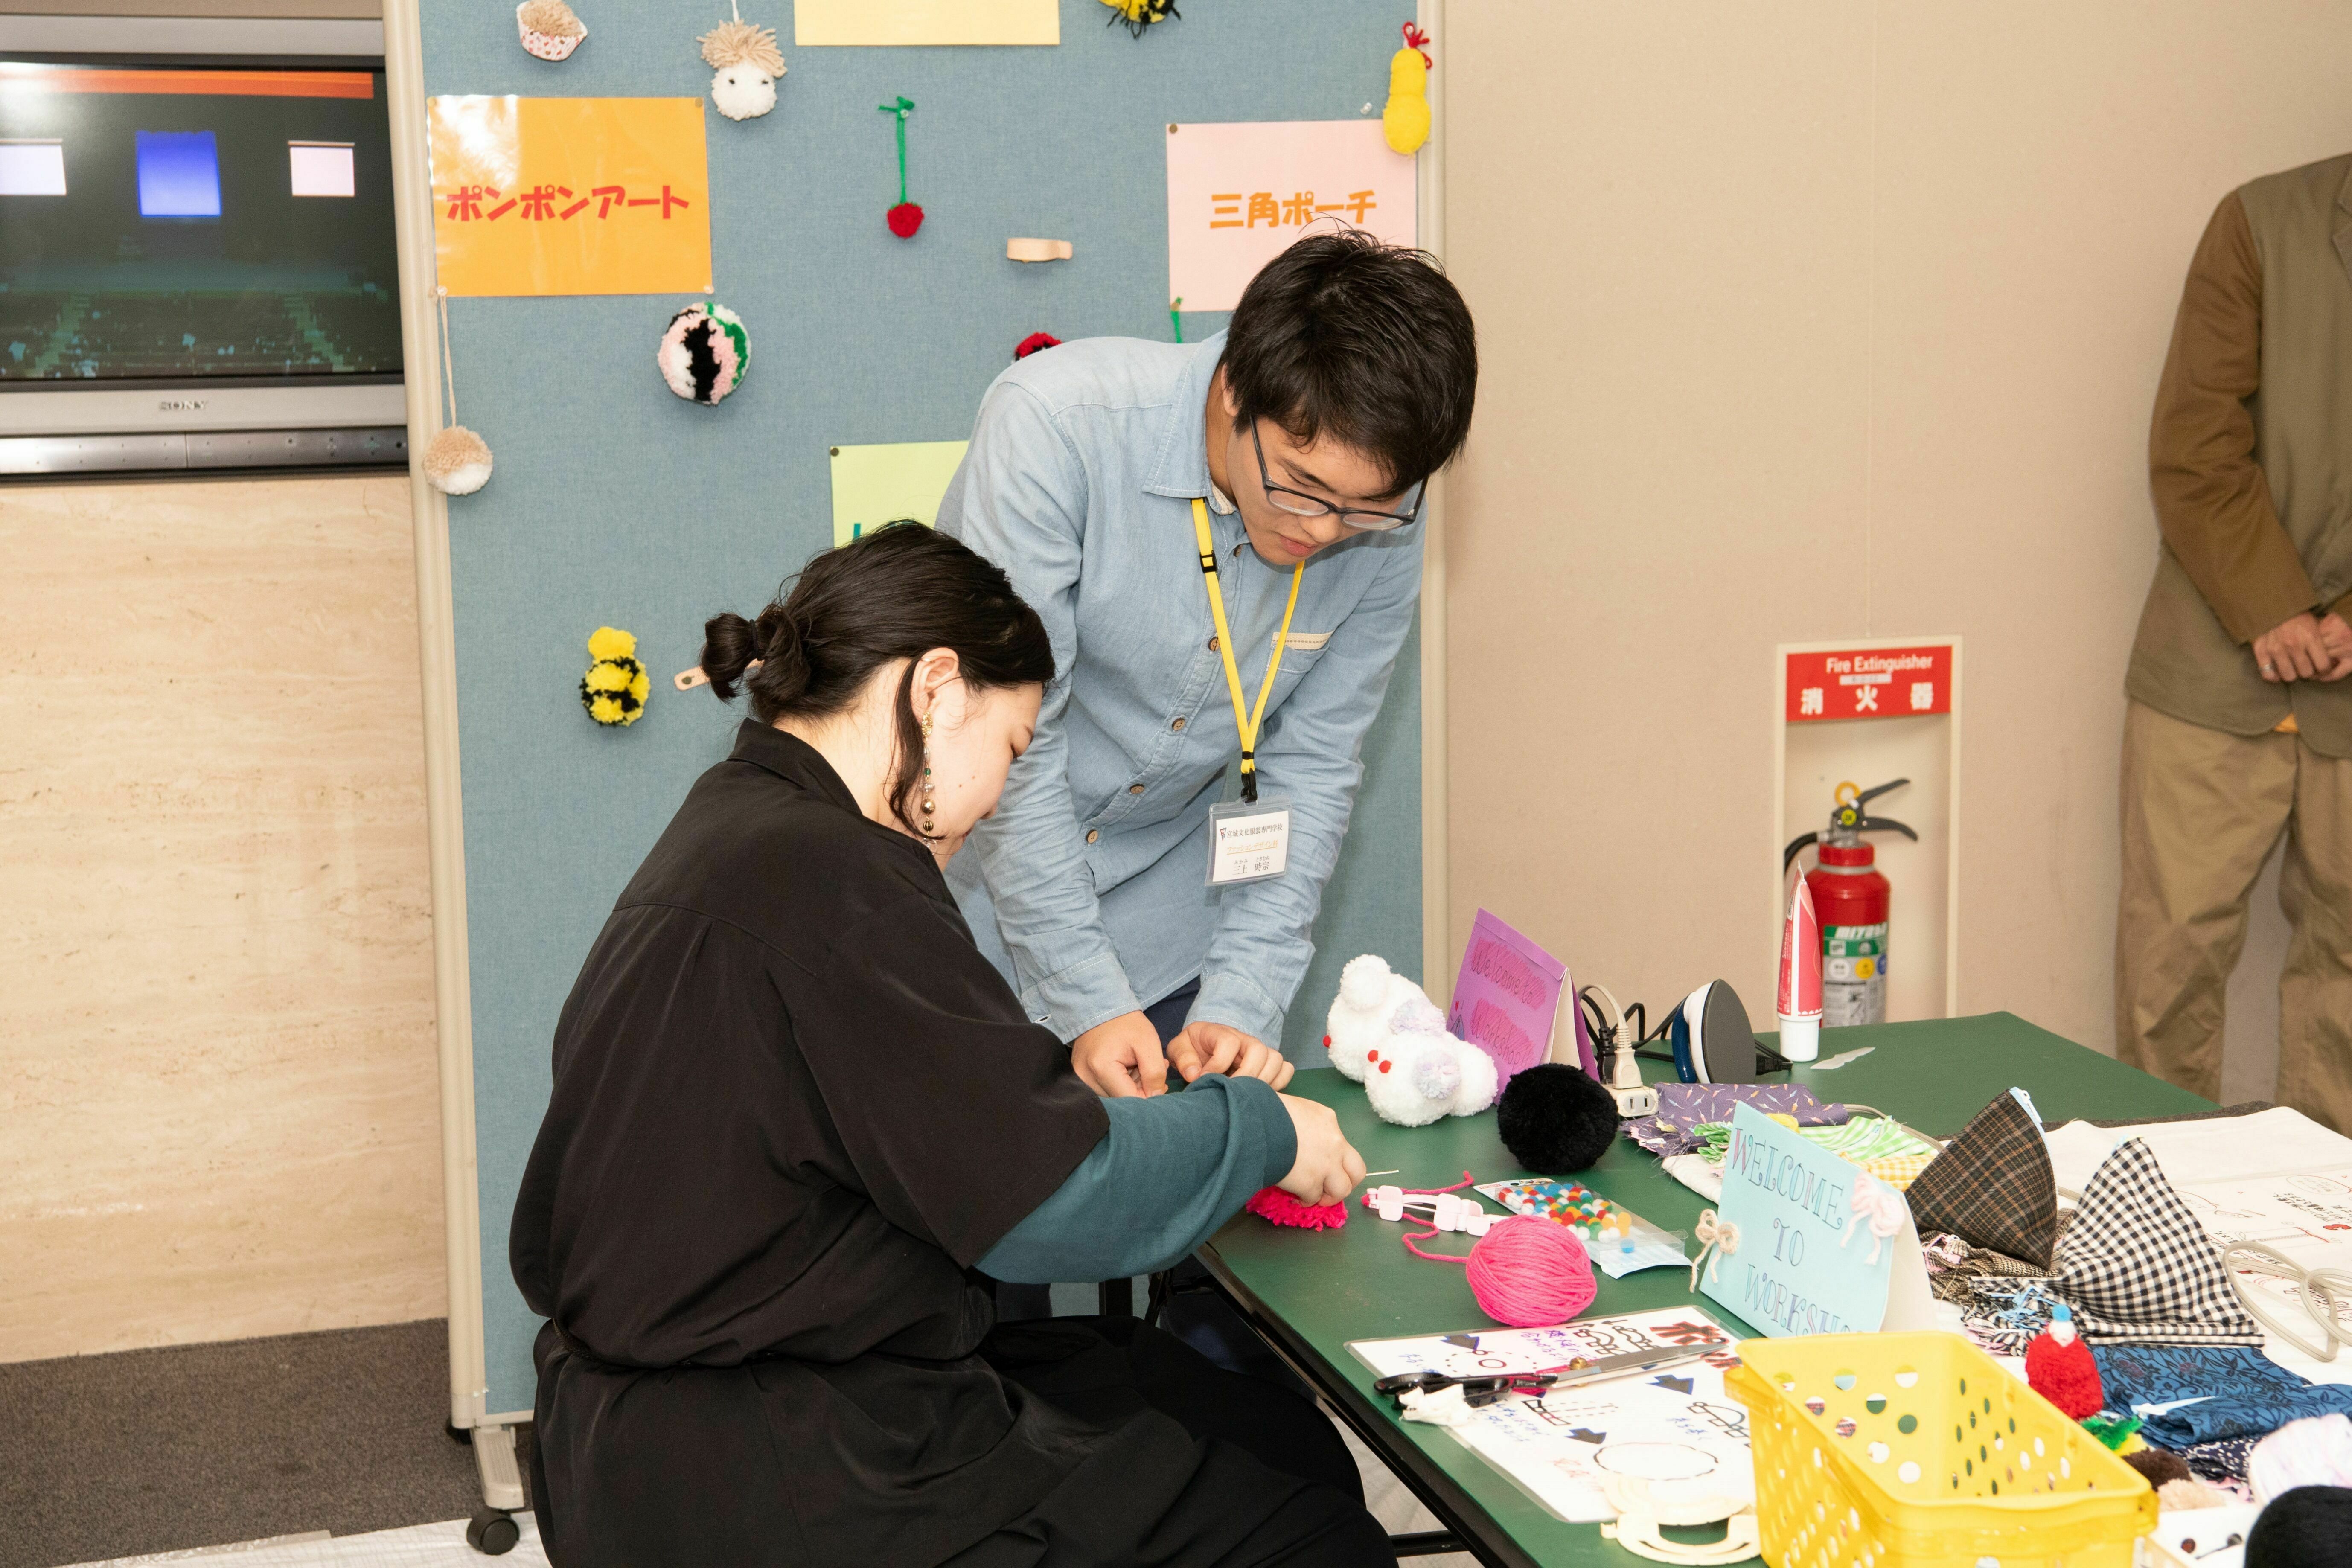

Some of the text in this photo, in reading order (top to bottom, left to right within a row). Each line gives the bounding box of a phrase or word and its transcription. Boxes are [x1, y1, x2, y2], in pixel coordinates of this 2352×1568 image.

[447, 184, 690, 222] ポンポンアート
[1209, 189, 1377, 229] 三角ポーチ
[1826, 654, 1933, 674] Fire Extinguisher
[1471, 939, 1520, 995] Welcome
[1732, 1127, 1843, 1230] WELCOME
[1773, 1217, 1804, 1267] TO
